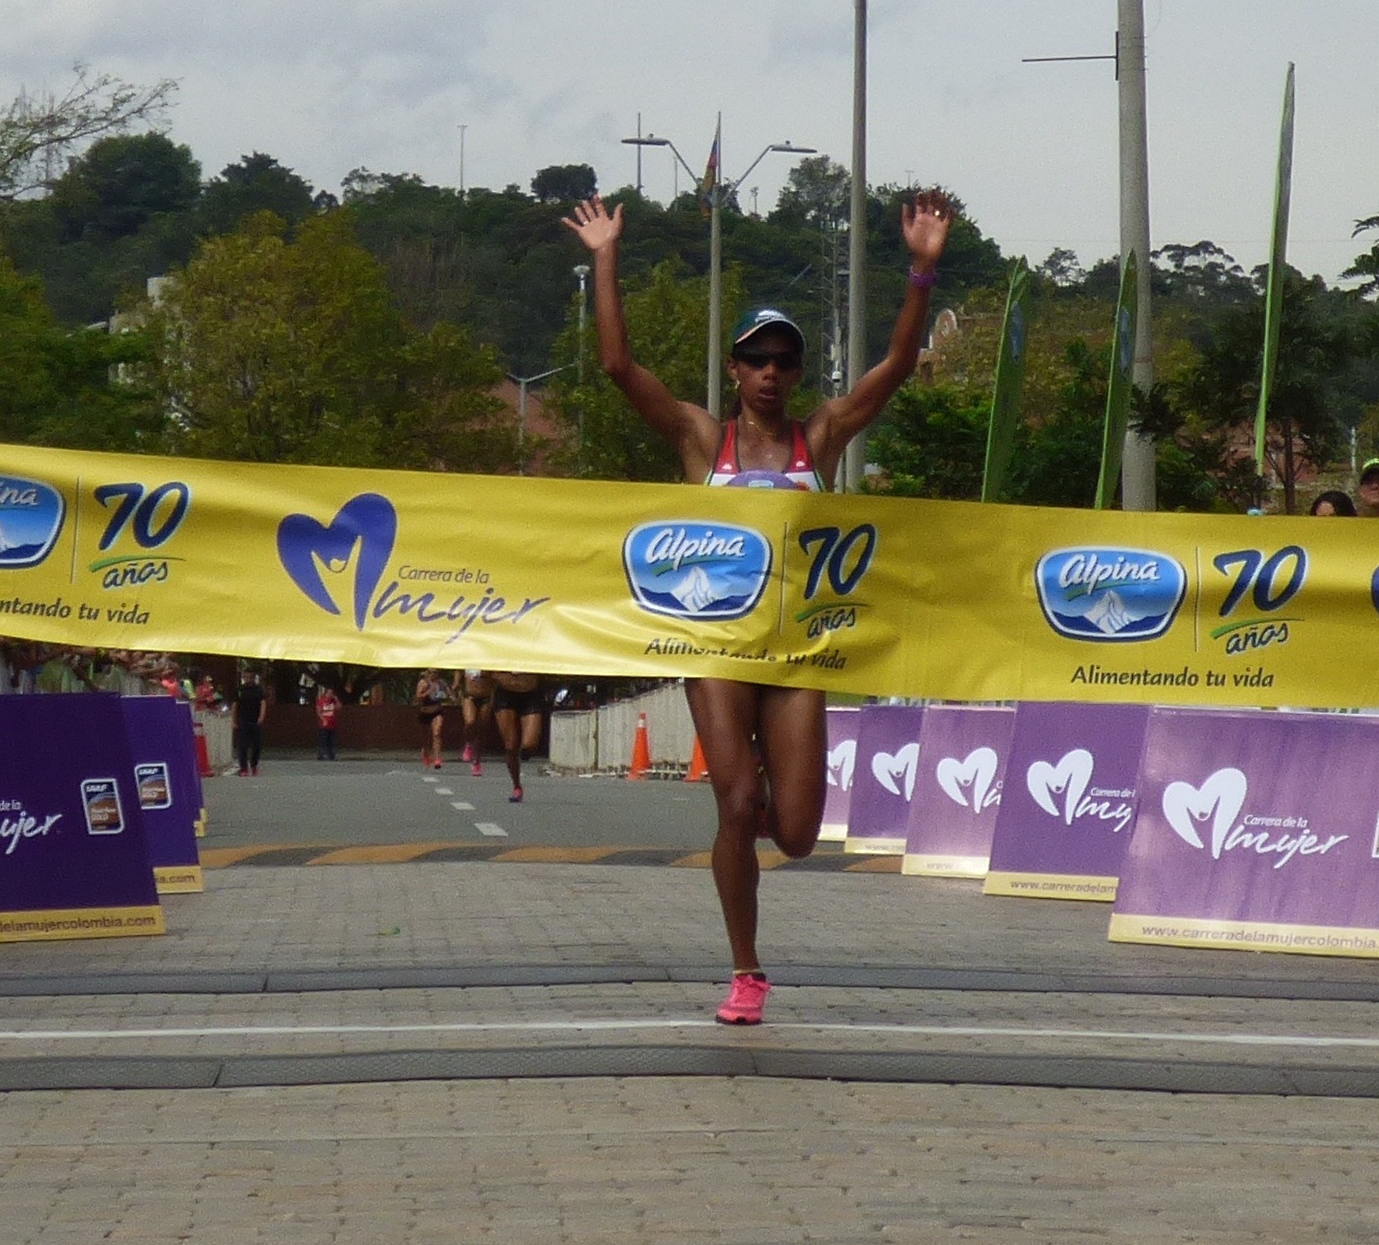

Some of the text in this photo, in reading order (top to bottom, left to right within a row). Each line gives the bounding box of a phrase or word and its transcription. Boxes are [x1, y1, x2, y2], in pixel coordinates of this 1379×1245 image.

[94, 481, 189, 551] 70
[645, 528, 746, 572] Alpina
[798, 523, 876, 600] 70
[102, 559, 168, 589] años
[398, 564, 489, 585] Carrera de la
[1059, 554, 1161, 594] Alpina
[1213, 545, 1308, 616] 70
[78, 604, 99, 621] tu
[108, 603, 150, 625] vida
[372, 581, 551, 644] mujer
[1225, 622, 1289, 655] años
[811, 649, 847, 670] vida
[1071, 665, 1274, 687] Alimentando tu vida
[11, 800, 21, 811] la
[1243, 814, 1308, 828] Carrera de la
[1225, 824, 1349, 869] mujer
